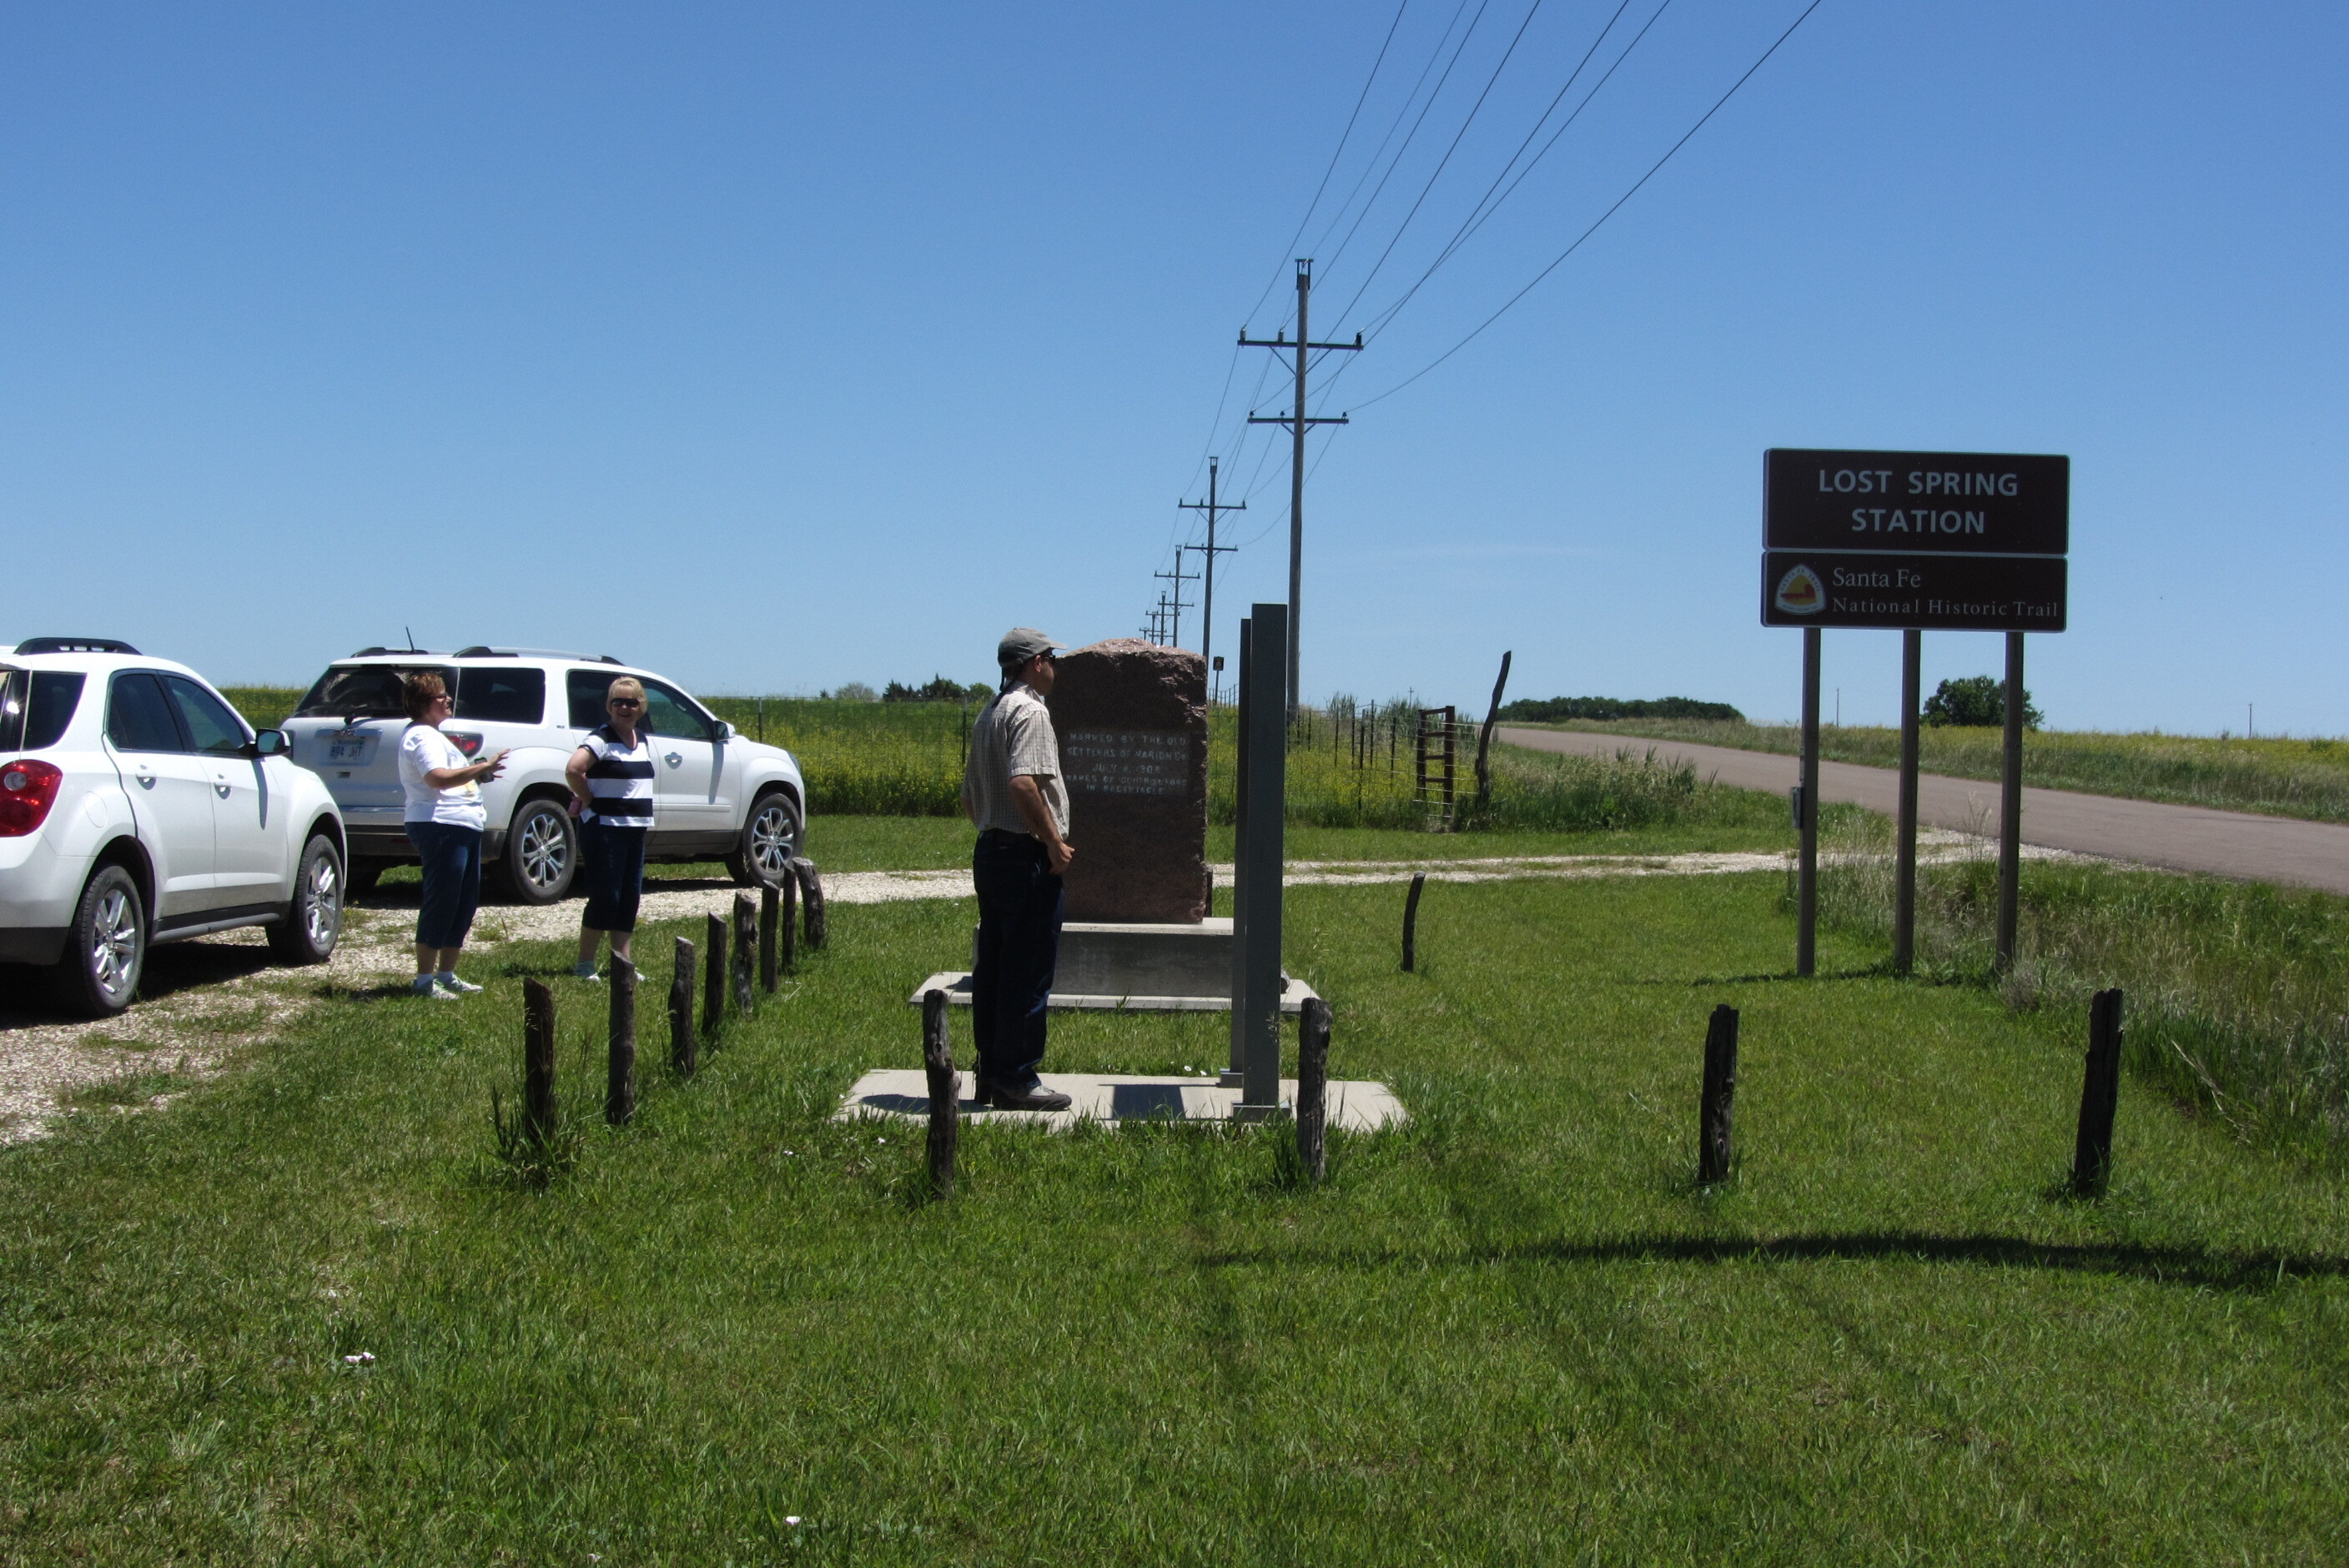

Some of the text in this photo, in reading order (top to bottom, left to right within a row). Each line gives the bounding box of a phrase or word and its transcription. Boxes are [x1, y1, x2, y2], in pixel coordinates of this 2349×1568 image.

[1818, 470, 2018, 496] LOST SPRING
[1852, 509, 1985, 534] STATION
[1833, 567, 1921, 589] Santa Fe
[1832, 598, 2058, 617] National Historic Trail
[1069, 733, 1186, 746] MARKED BY THE OLD
[1067, 746, 1116, 757] SETTLERS
[1119, 748, 1131, 758] OF
[1135, 750, 1172, 761] MARION
[1093, 763, 1118, 774] JULY
[1066, 774, 1098, 782] NAMES
[1102, 776, 1114, 784] OF
